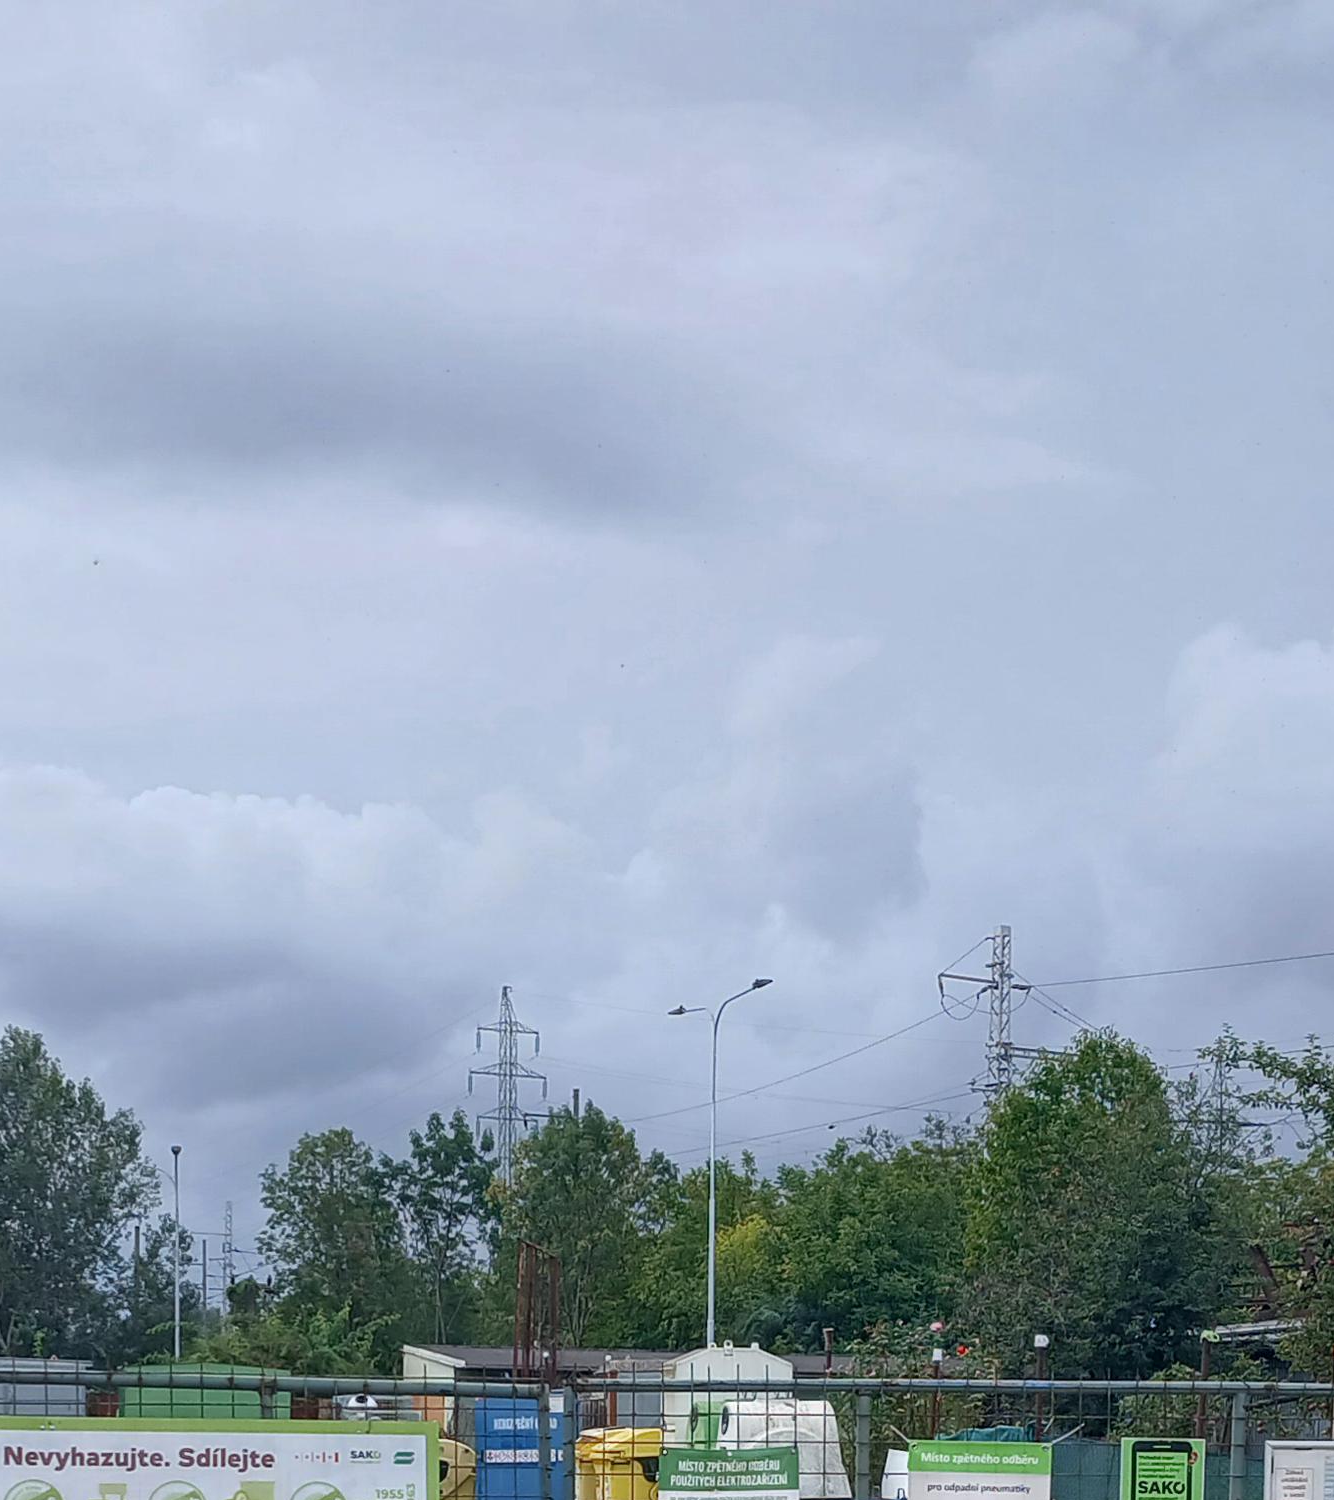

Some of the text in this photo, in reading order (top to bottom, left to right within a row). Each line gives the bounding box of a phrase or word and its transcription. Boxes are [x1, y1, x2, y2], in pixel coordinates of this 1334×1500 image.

[3, 1446, 171, 1472] Nevyhazujte.
[178, 1447, 275, 1473] Sdílejte
[350, 1450, 382, 1460] SAKO
[921, 1452, 1039, 1465] Místo zpětného odběru
[678, 1459, 705, 1472] MÍSTO
[707, 1460, 747, 1473] ZPĚTNÉHO
[670, 1472, 788, 1487] POUŽITÝCH ELEKTROZAŘÍZENÍ
[375, 1489, 404, 1499] 1955
[927, 1483, 1031, 1495] pro odpadní pneumatiky
[1138, 1481, 1185, 1494] SAKO
